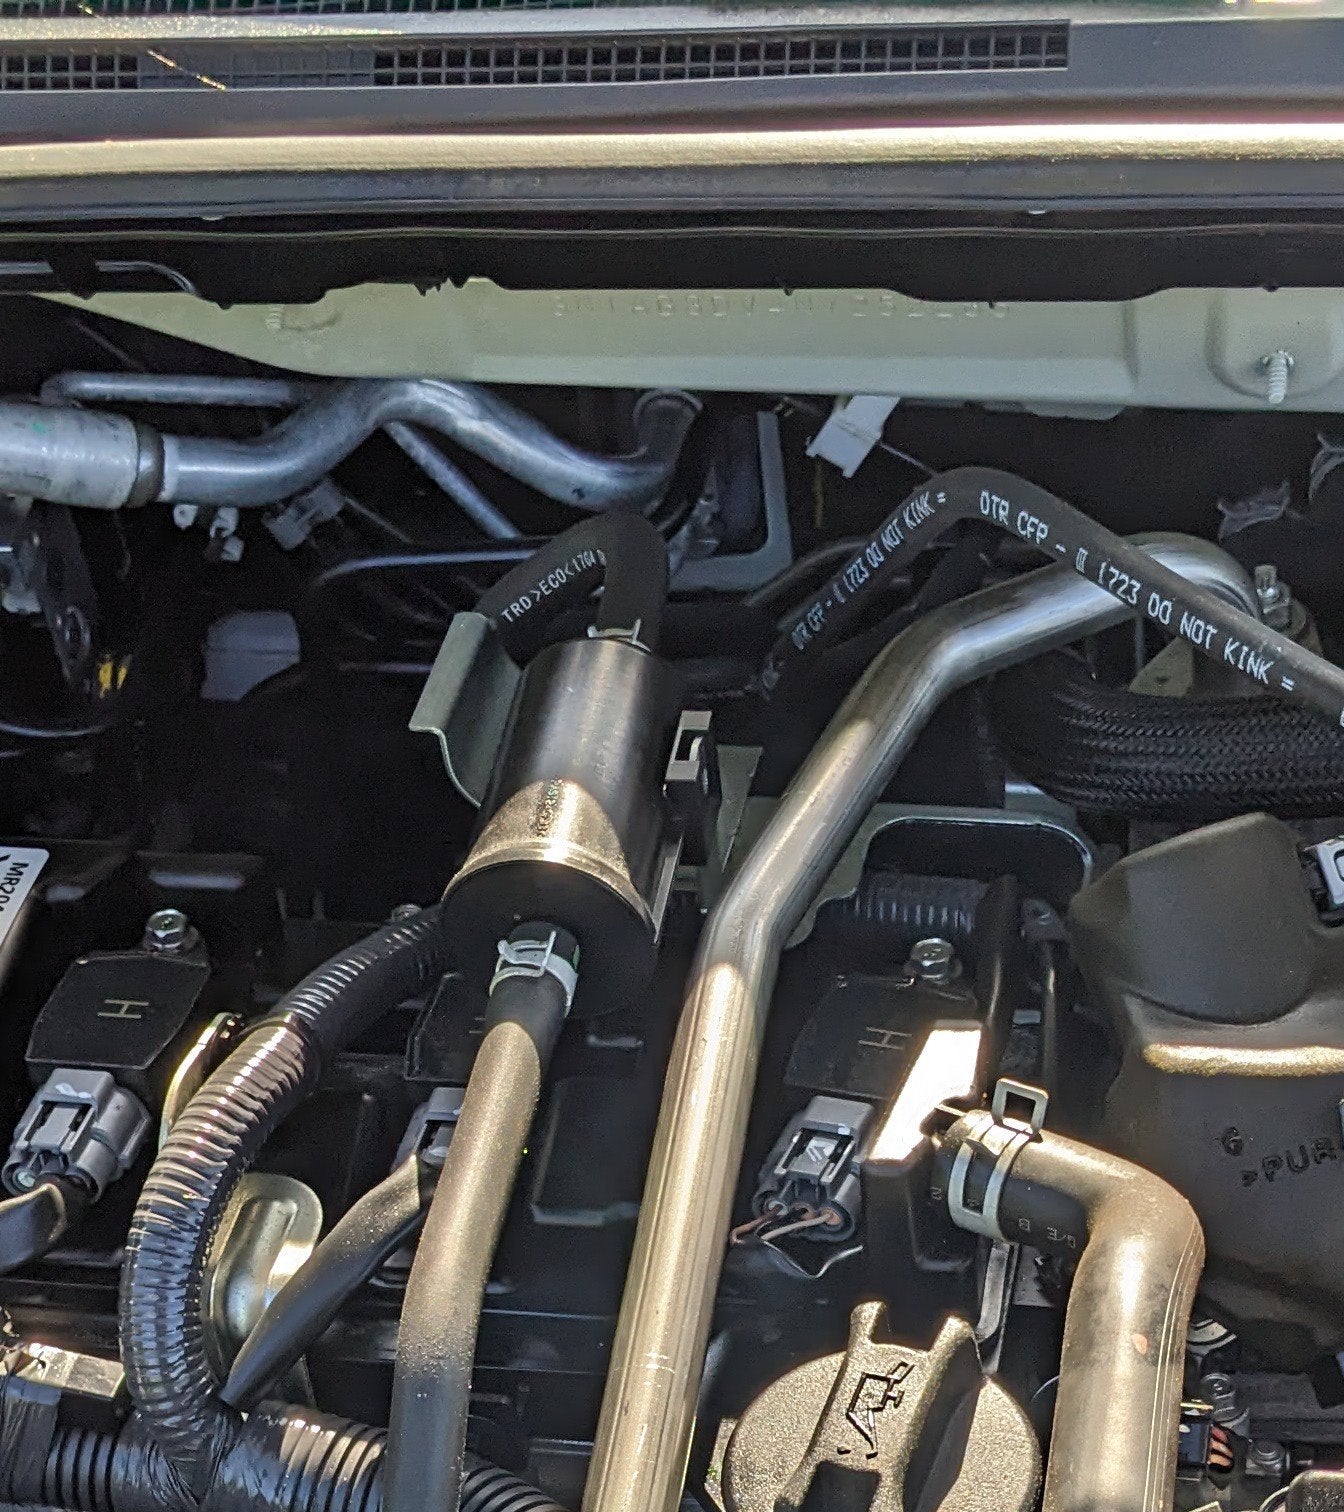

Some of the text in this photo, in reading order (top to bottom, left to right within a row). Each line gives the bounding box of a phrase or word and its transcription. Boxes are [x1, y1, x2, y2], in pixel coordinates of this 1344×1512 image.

[842, 556, 871, 593] 1723
[880, 517, 906, 553] NOT
[903, 490, 933, 533] KINK
[1017, 509, 1050, 544] CFP
[1098, 558, 1141, 605] 1723
[1146, 591, 1171, 624] DO
[1178, 611, 1217, 648] NOT
[1223, 636, 1274, 684] KINK
